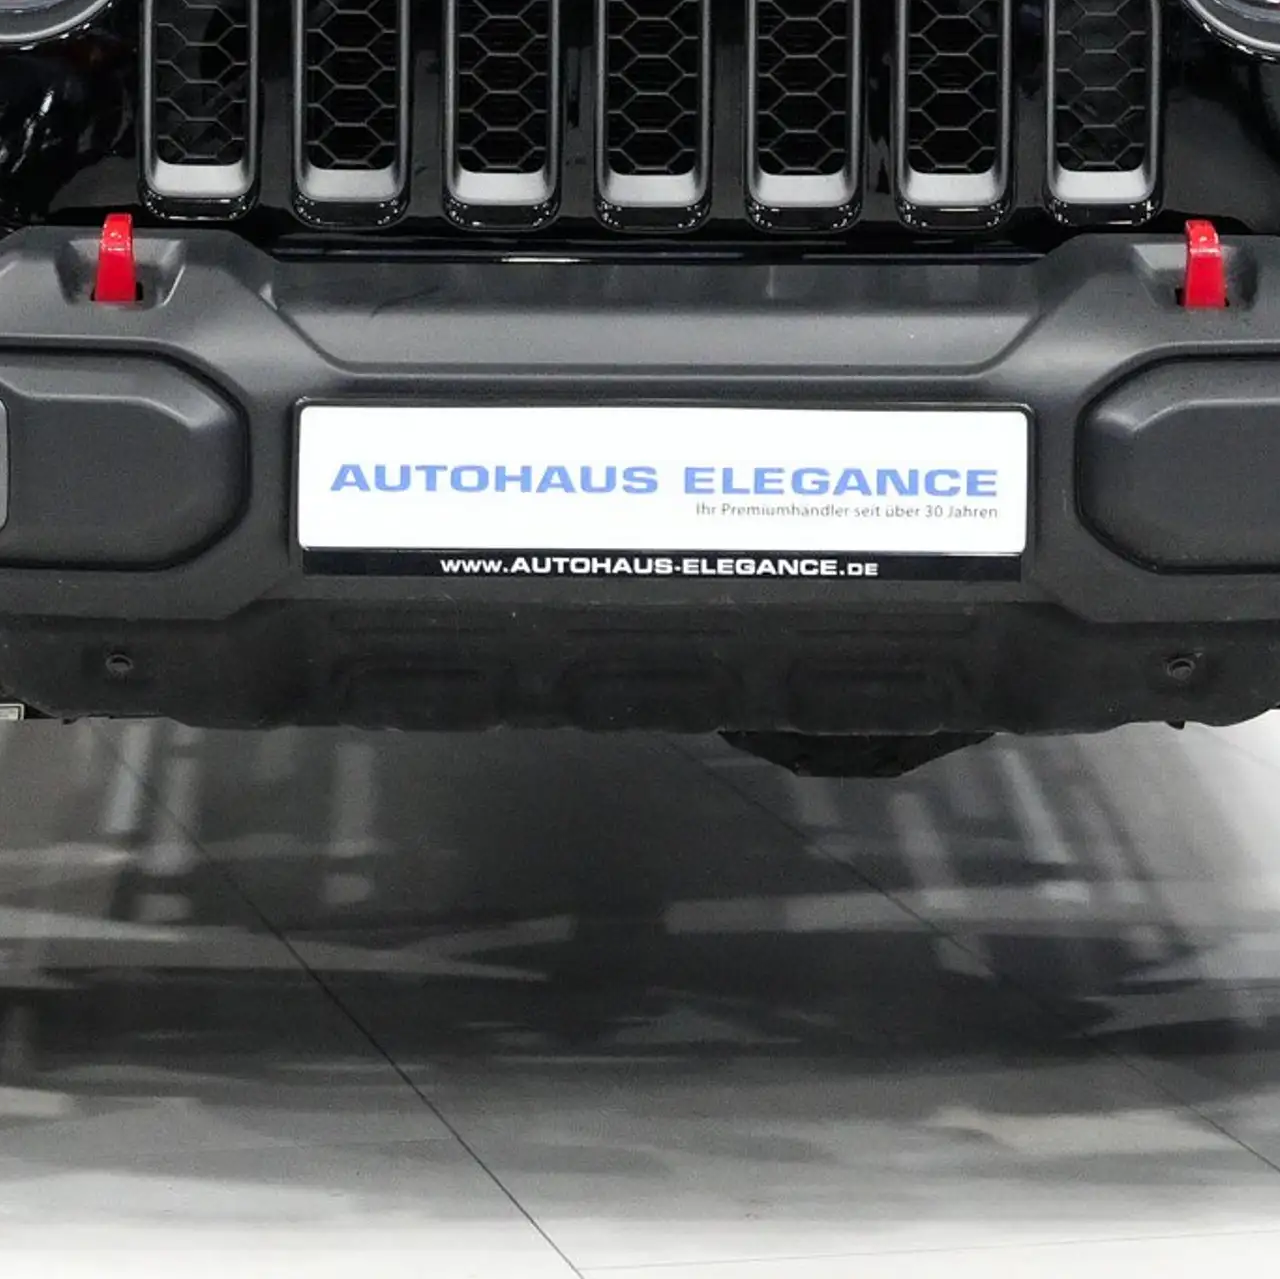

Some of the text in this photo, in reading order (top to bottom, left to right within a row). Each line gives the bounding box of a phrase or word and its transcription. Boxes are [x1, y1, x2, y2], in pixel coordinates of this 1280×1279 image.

[330, 463, 997, 497] AUTOHAUS ELEGANCE
[696, 502, 717, 515] Ihr
[854, 504, 881, 518] seit
[885, 504, 920, 518] über
[925, 505, 944, 518] 30
[947, 505, 998, 519] Jahren
